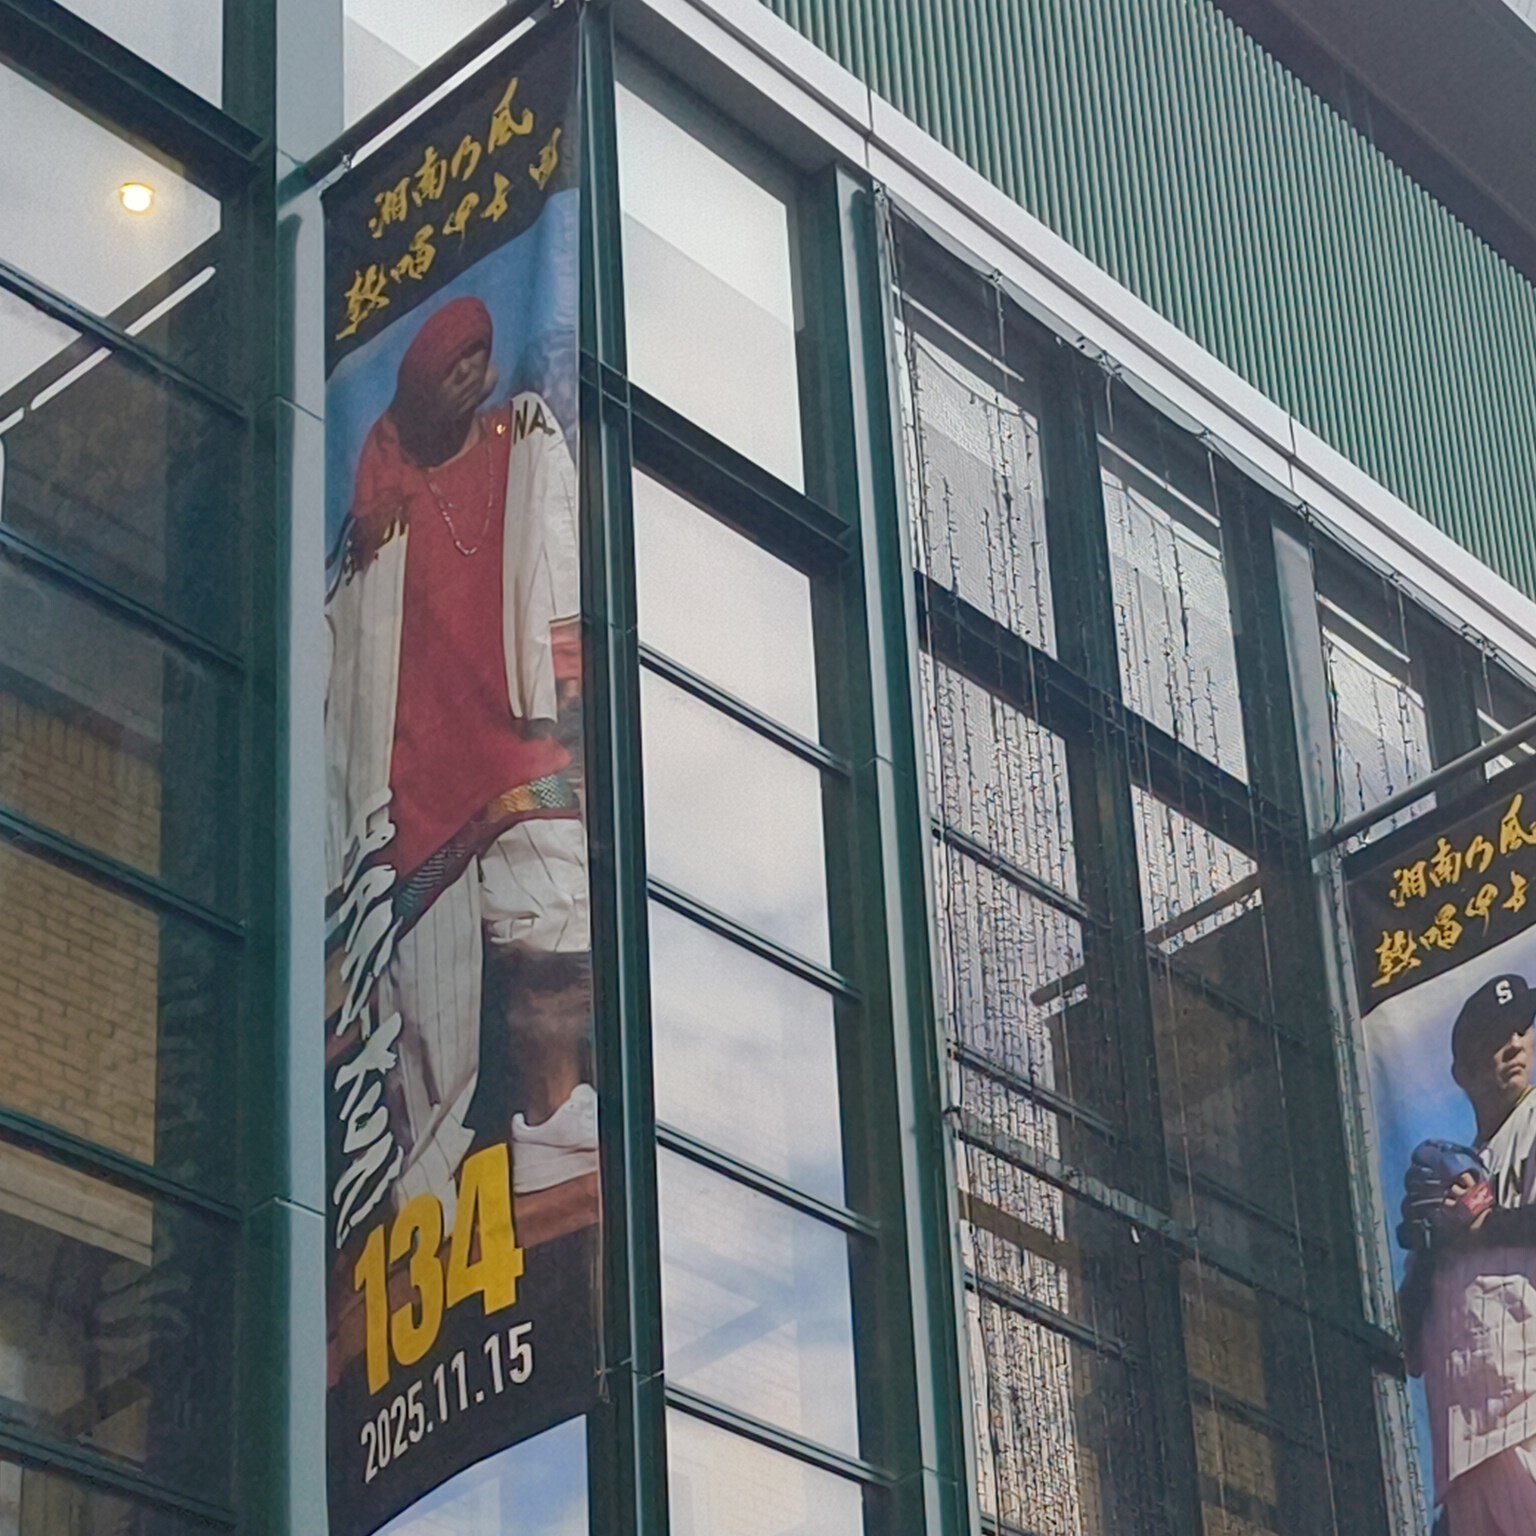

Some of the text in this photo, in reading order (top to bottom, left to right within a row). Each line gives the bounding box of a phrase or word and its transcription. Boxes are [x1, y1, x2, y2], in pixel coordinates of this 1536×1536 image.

[1494, 979, 1514, 1005] S
[354, 1142, 524, 1396] 134
[360, 1321, 534, 1484] 2025.11.15
